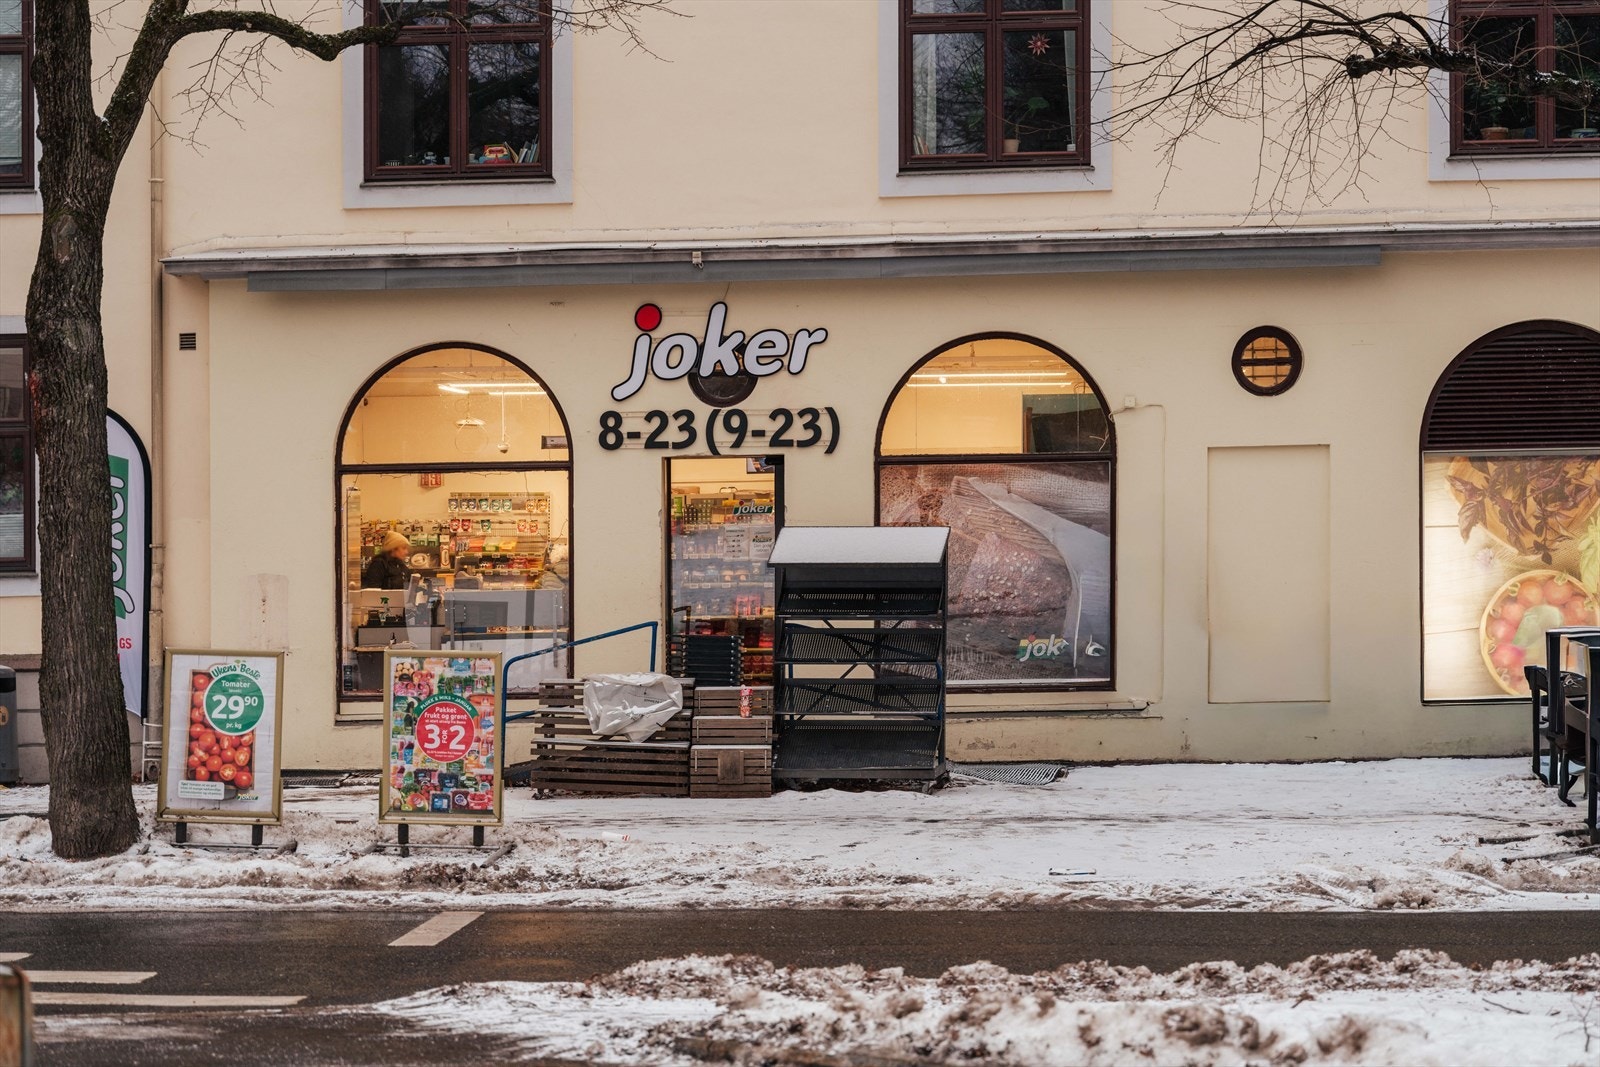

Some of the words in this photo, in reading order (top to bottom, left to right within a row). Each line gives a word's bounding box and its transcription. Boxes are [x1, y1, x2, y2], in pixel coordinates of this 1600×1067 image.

[611, 301, 828, 401] joker
[736, 500, 771, 515] joker
[211, 665, 237, 678] Ukens
[221, 680, 251, 688] Tomater
[423, 724, 440, 749] 3
[449, 725, 466, 750] 2
